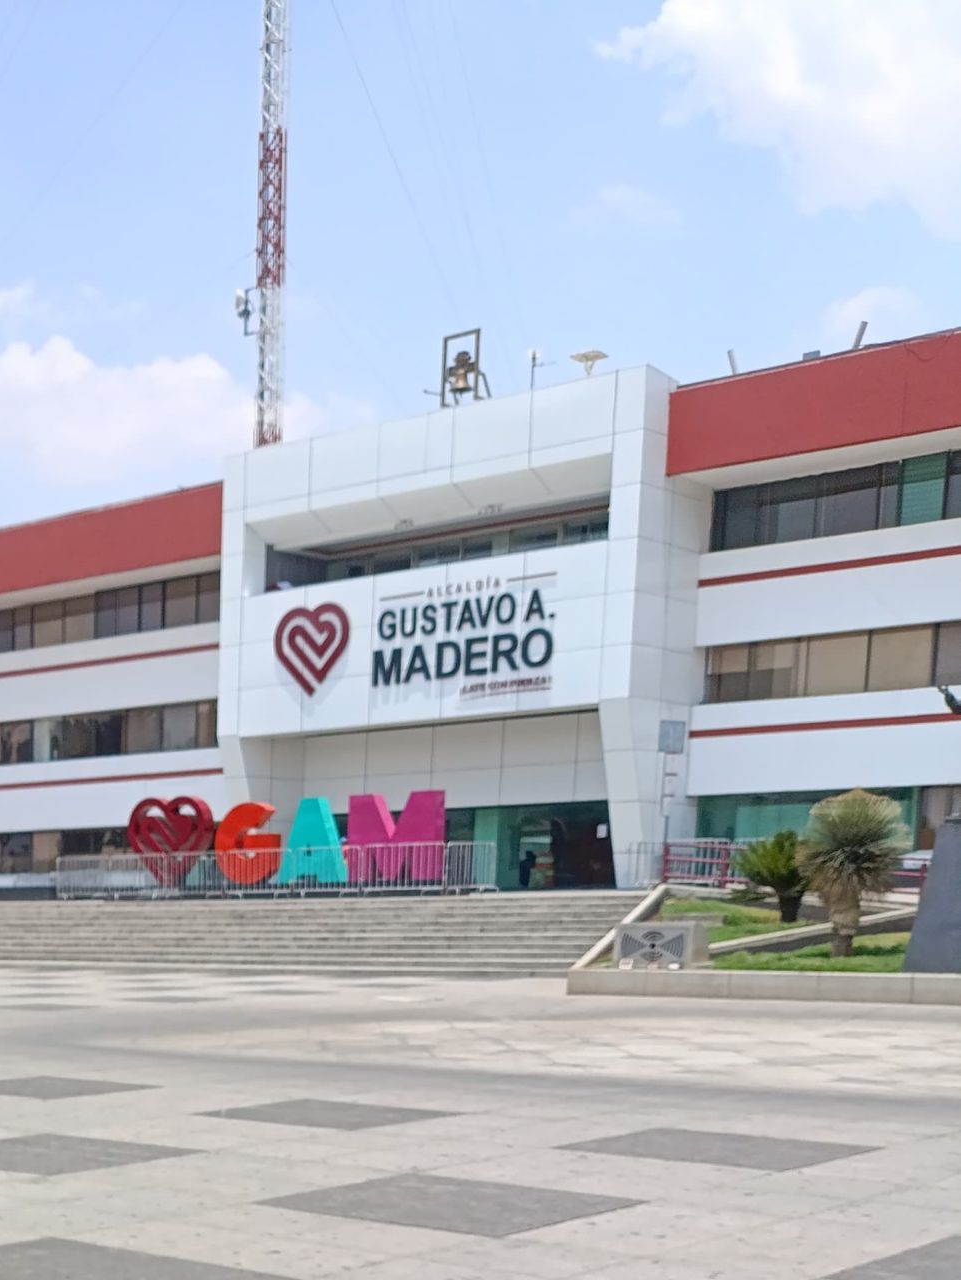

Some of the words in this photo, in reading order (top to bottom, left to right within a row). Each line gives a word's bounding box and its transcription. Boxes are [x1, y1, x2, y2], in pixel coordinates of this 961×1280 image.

[378, 593, 516, 641] GUSTAVO
[524, 589, 555, 622] A.
[372, 628, 553, 687] MADERO
[214, 790, 445, 886] GAM
